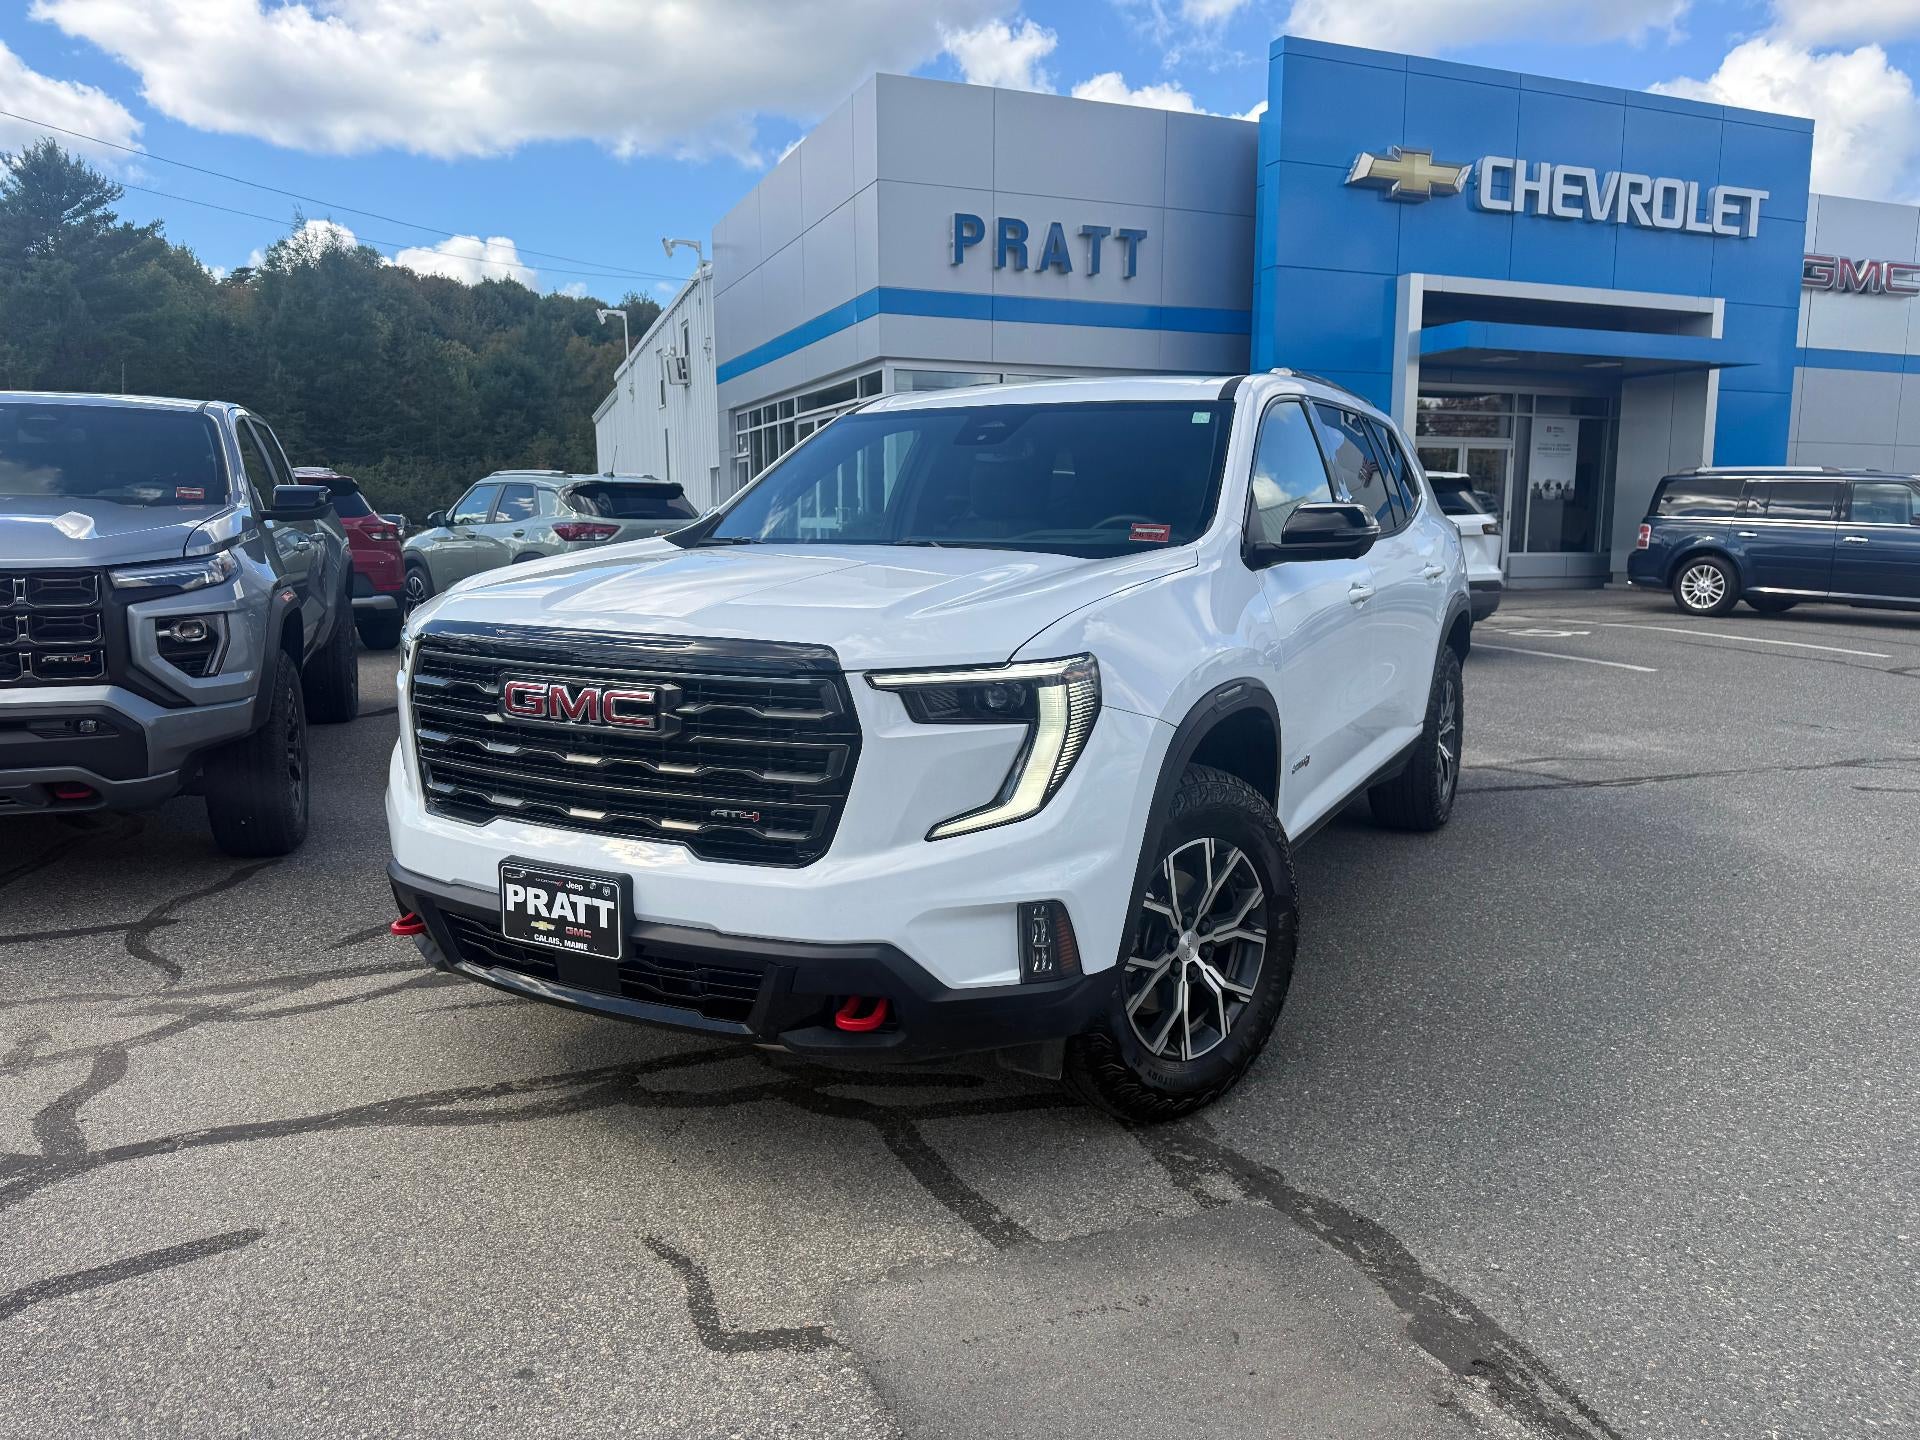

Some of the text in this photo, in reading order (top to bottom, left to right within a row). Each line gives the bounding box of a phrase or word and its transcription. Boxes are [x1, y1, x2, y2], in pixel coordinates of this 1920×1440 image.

[1478, 156, 1769, 237] CHEVROLET
[952, 213, 1148, 278] PRATT
[1803, 253, 1920, 295] GMC
[505, 681, 656, 728] GMC
[710, 808, 760, 822] AT4
[506, 883, 615, 928] PRATT
[566, 881, 584, 892] Jeep
[534, 933, 588, 951] CALAIS, MAINE
[565, 926, 592, 939] GMC
